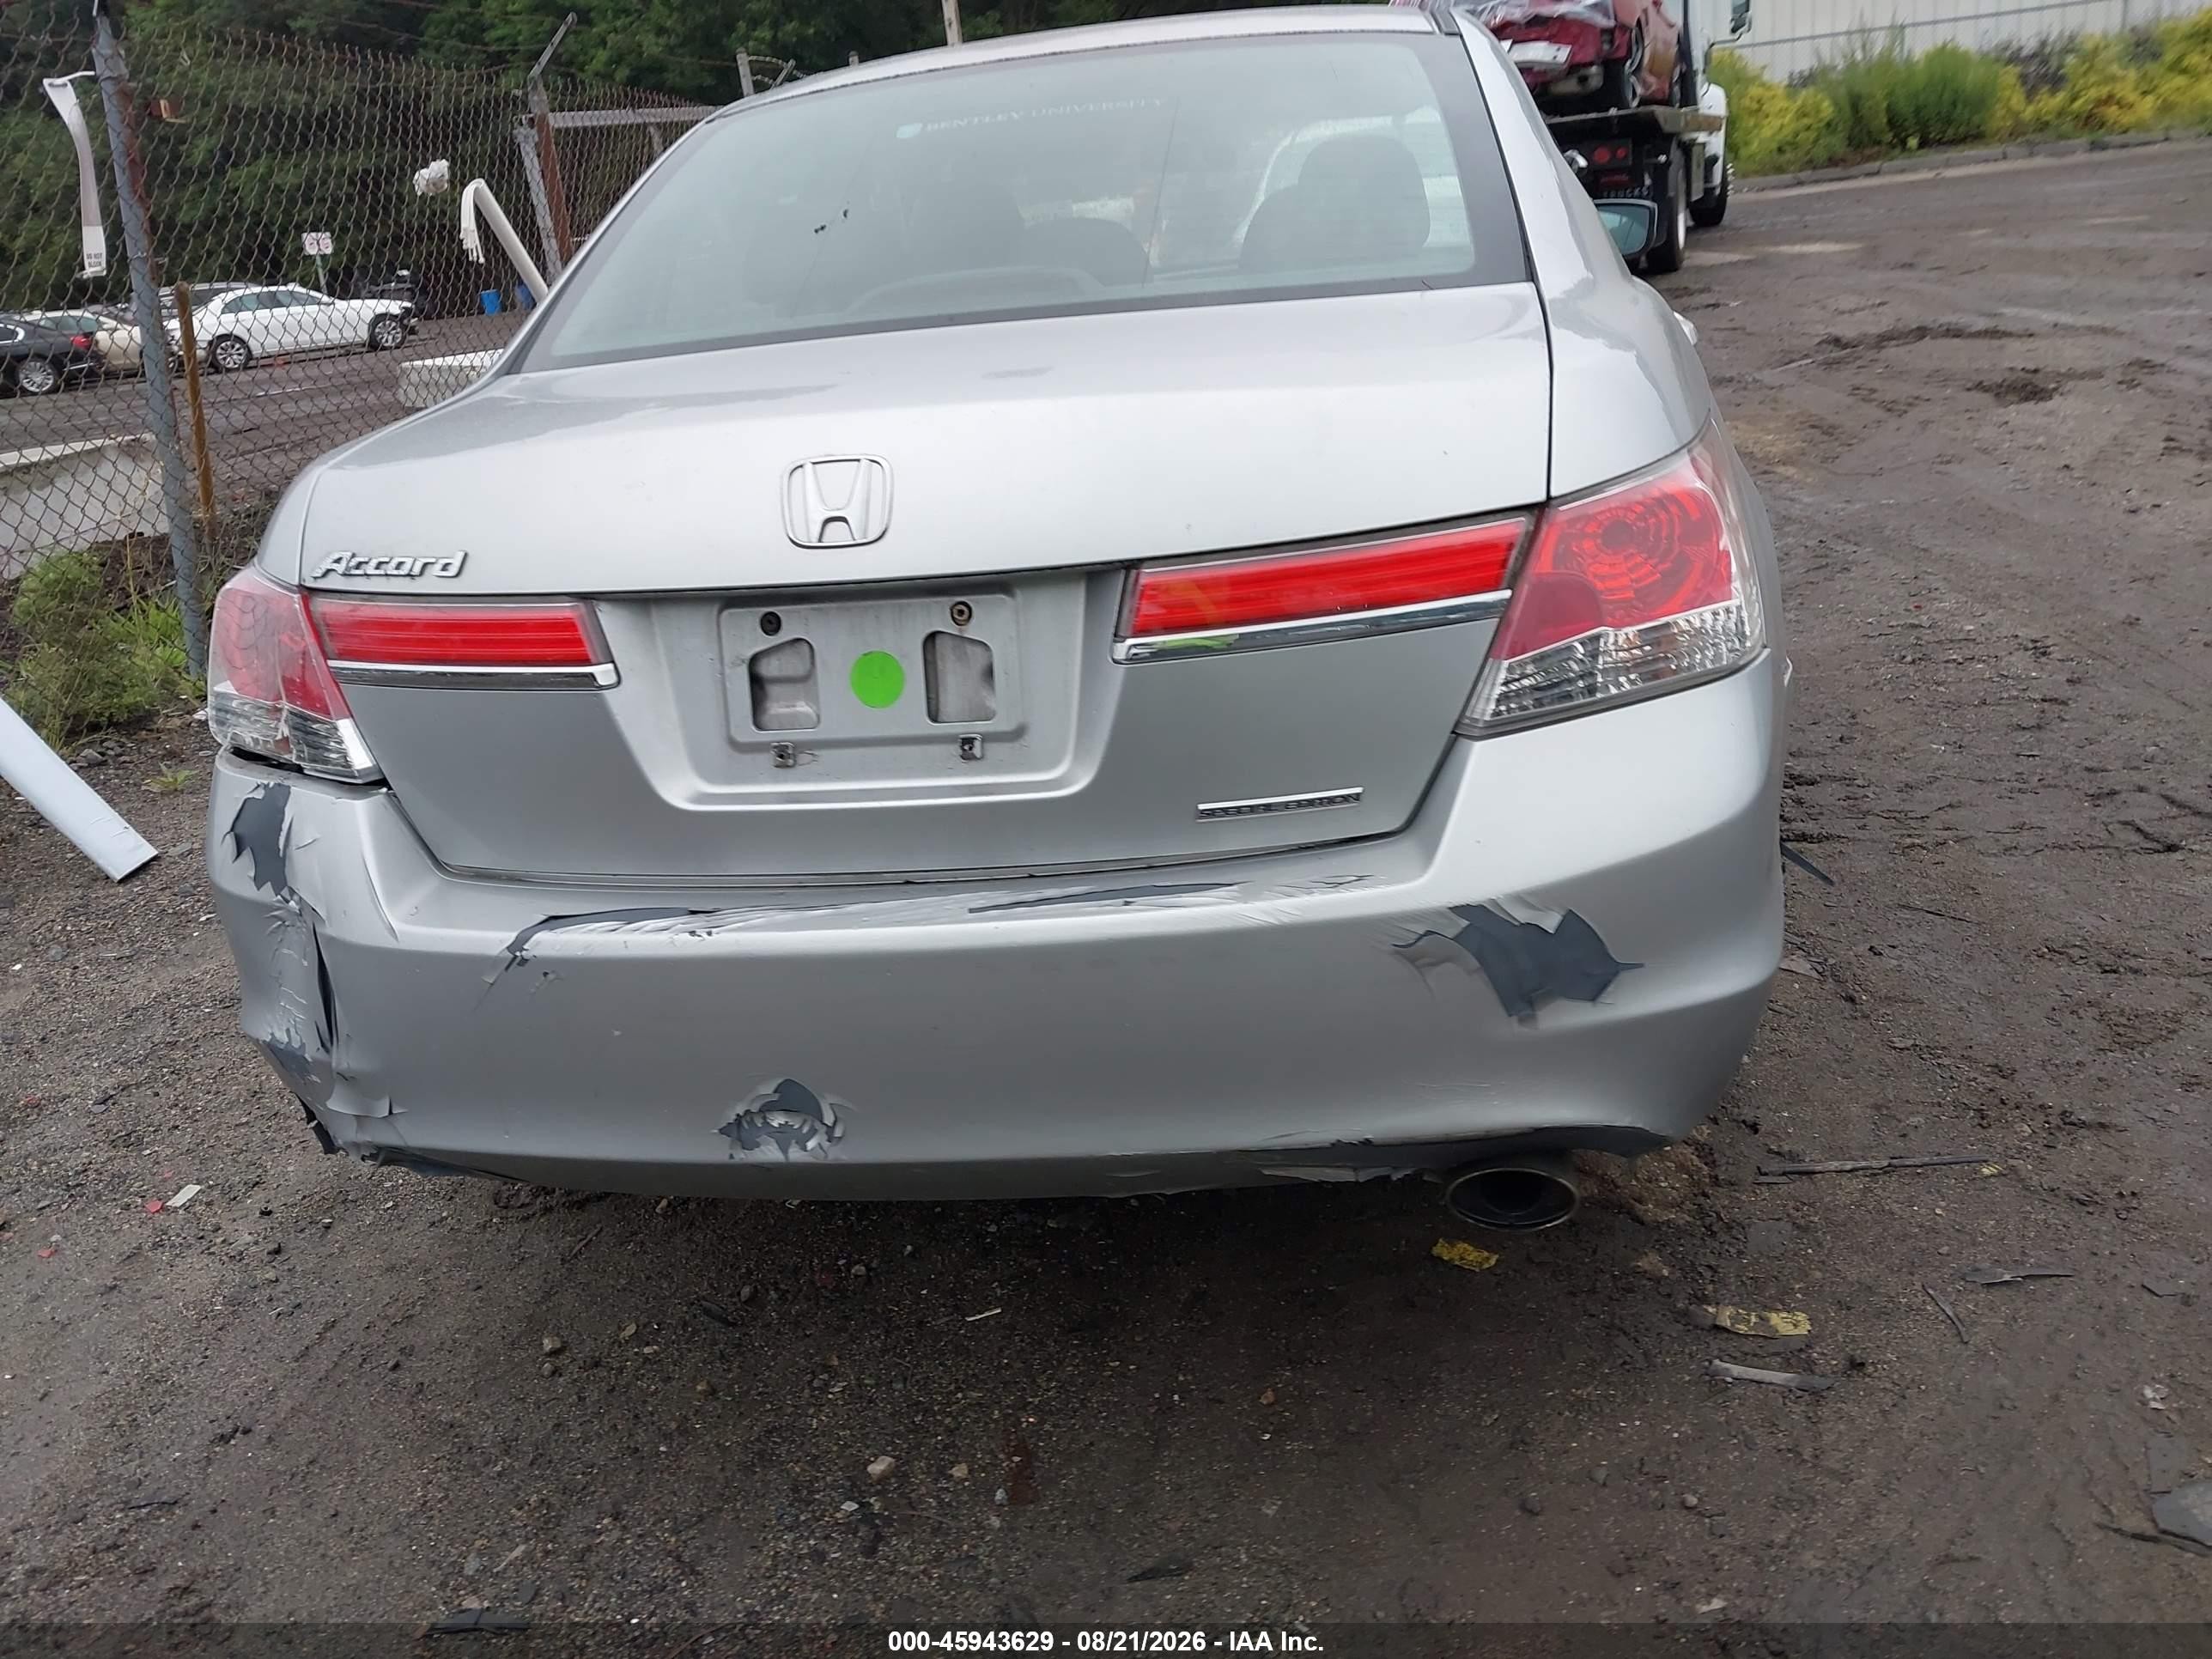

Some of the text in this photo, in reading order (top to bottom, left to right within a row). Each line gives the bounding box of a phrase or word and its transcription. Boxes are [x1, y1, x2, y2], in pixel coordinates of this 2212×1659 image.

[925, 95, 1167, 132] BENTLEY UNIVERSITY
[311, 550, 469, 578] Accord
